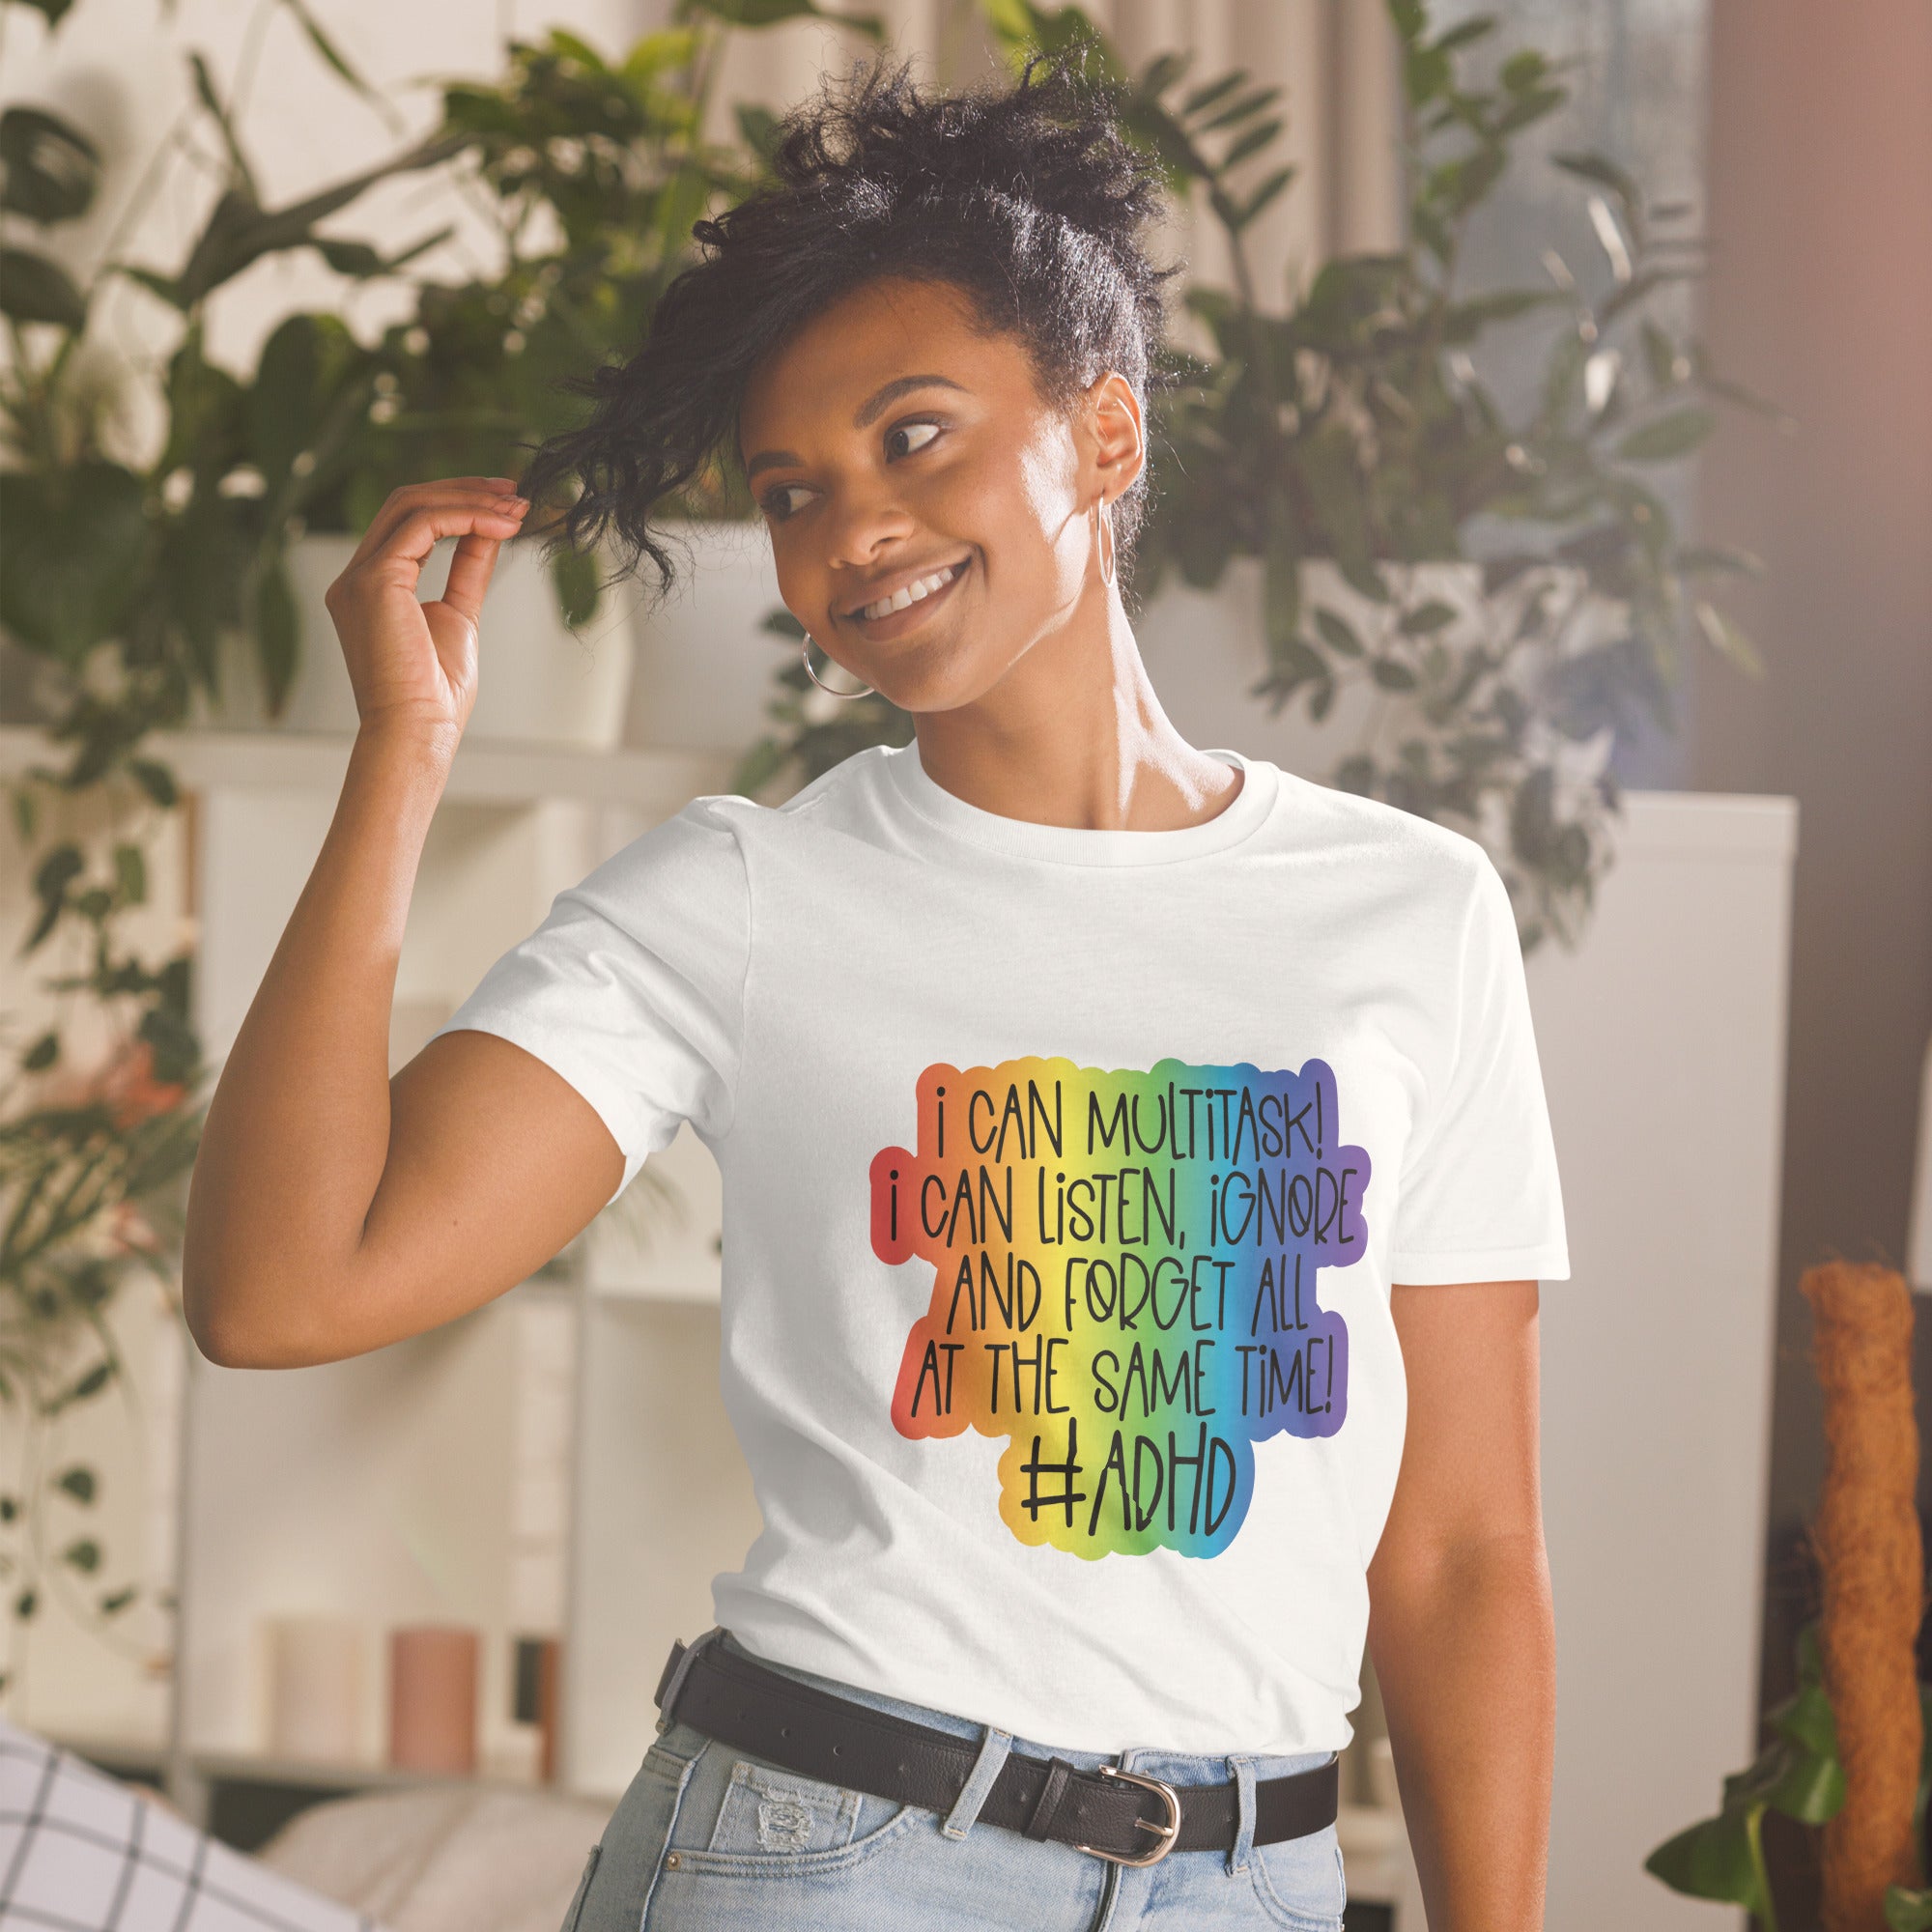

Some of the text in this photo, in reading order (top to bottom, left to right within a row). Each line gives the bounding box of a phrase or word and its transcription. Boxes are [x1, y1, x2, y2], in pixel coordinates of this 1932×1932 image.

[969, 1079, 1063, 1163] CAN
[921, 1165, 1012, 1248] CAN
[946, 1250, 1308, 1337] AND FORGET ALL
[911, 1339, 965, 1418] AT
[983, 1333, 1070, 1415] THE
[1092, 1339, 1216, 1422] SAME
[1019, 1416, 1236, 1537] #ADHD
